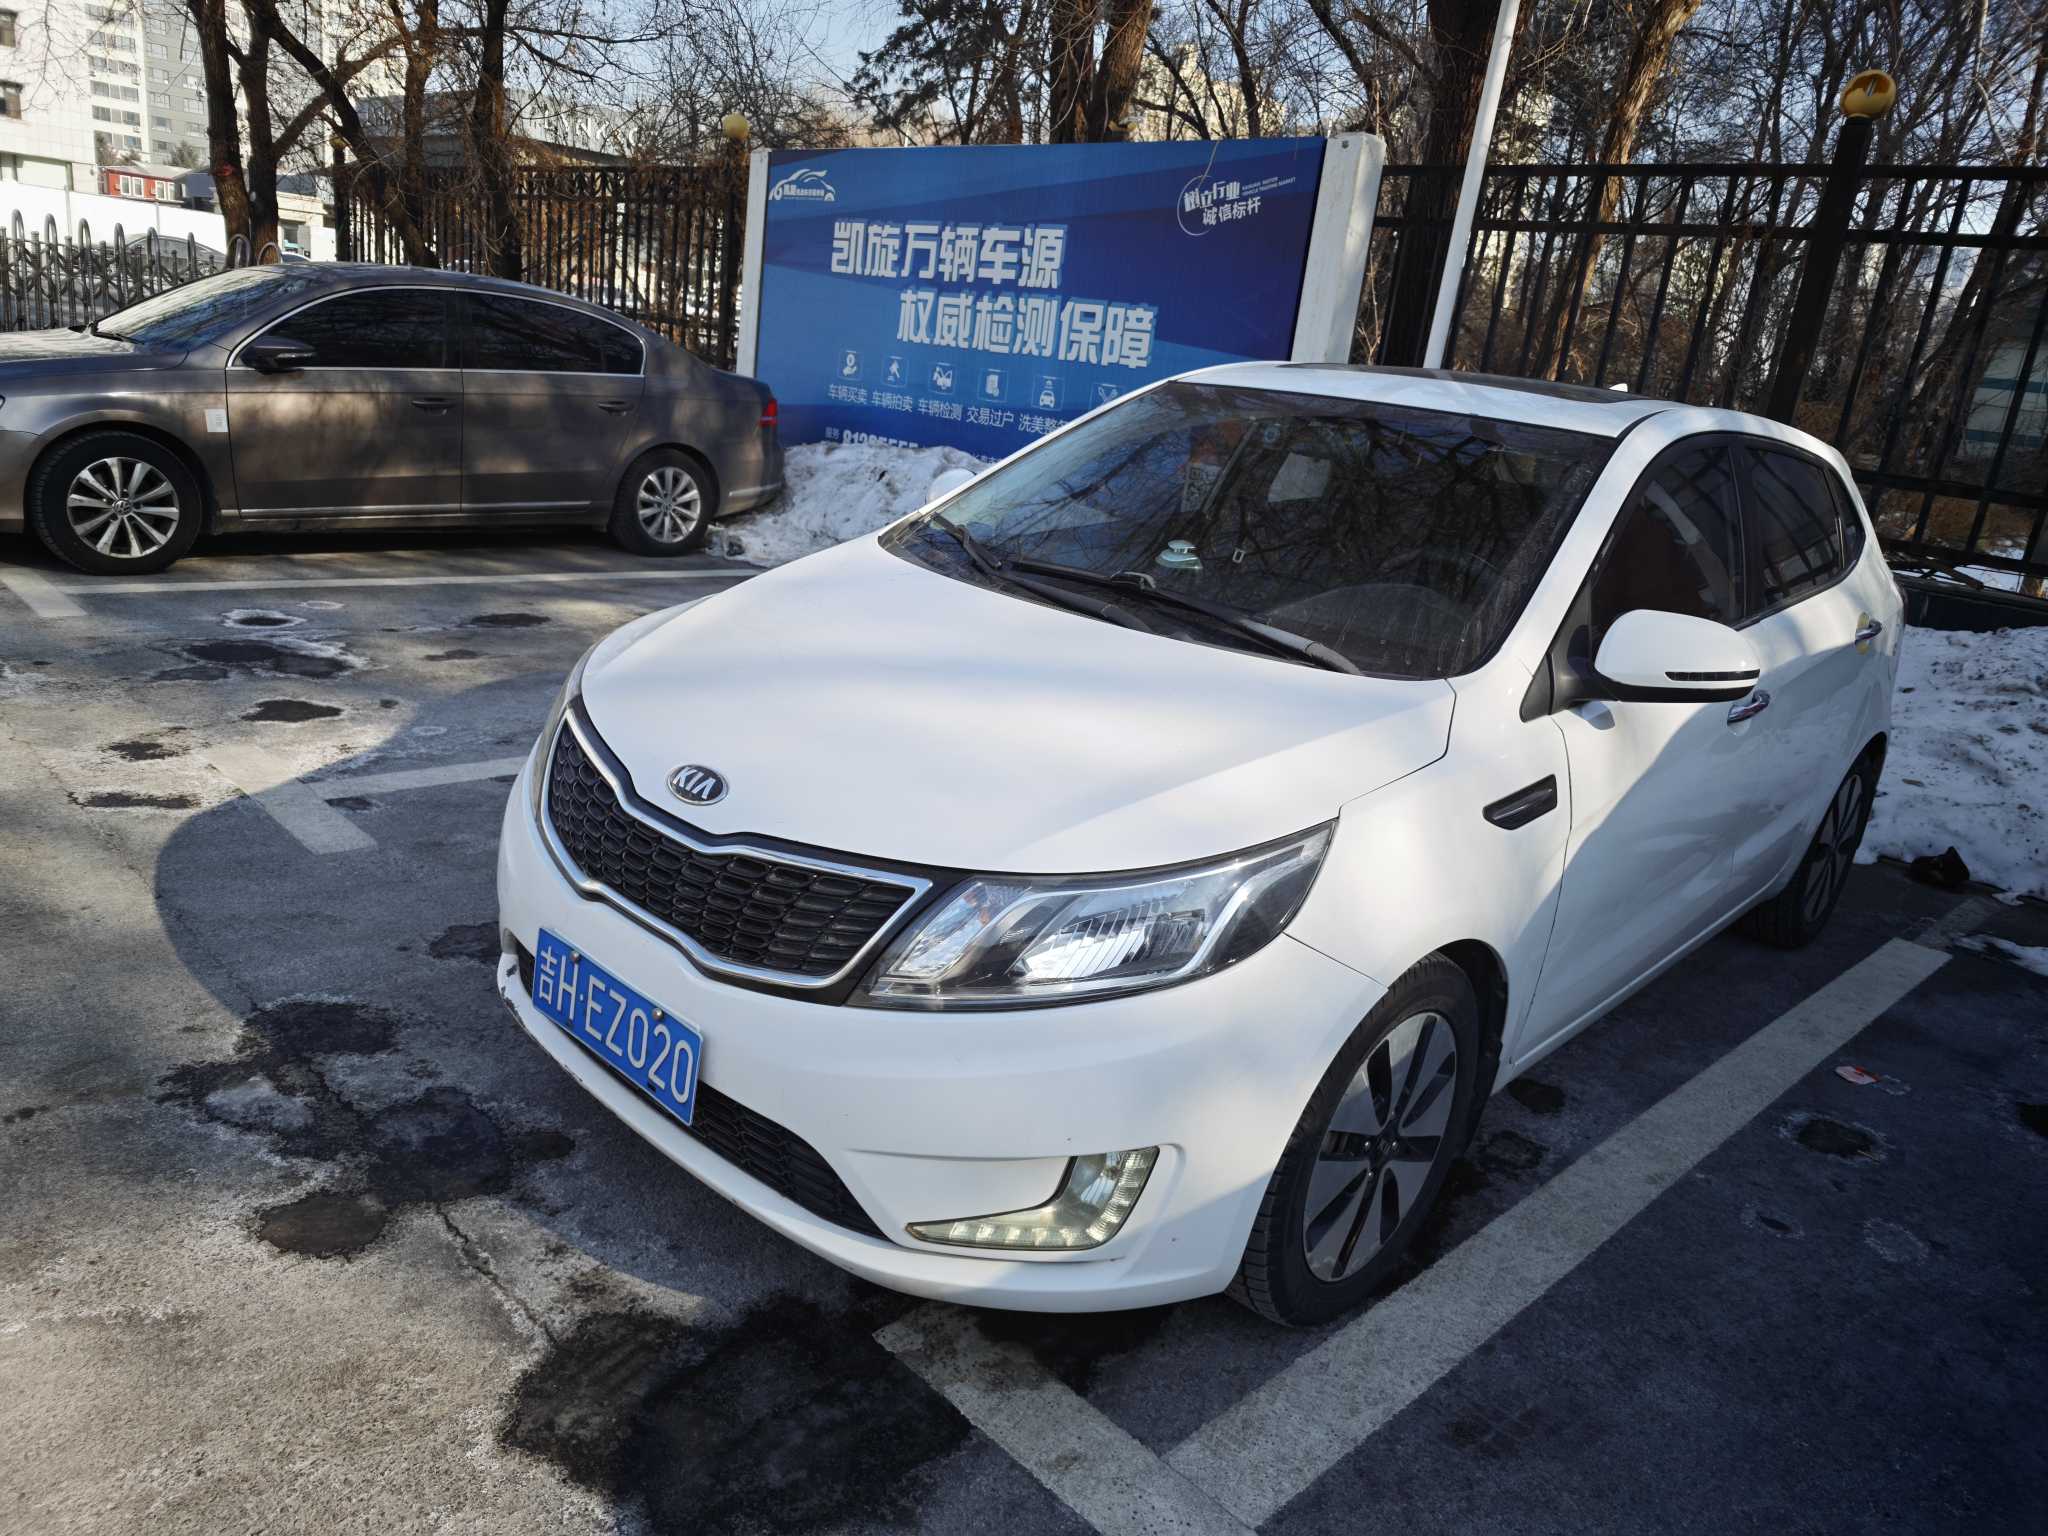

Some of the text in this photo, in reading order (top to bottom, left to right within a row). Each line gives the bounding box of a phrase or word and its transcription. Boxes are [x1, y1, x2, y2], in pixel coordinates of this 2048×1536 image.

[1202, 196, 1261, 226] 诚信标杆
[831, 221, 1065, 289] 凯旋万辆车源
[896, 290, 1154, 369] 权威检测保障
[828, 383, 868, 405] 车辆买卖
[871, 391, 913, 412] 车辆拍卖
[917, 398, 963, 421] 车辆检测
[967, 406, 1015, 428] 交易过户
[672, 766, 716, 800] KIA
